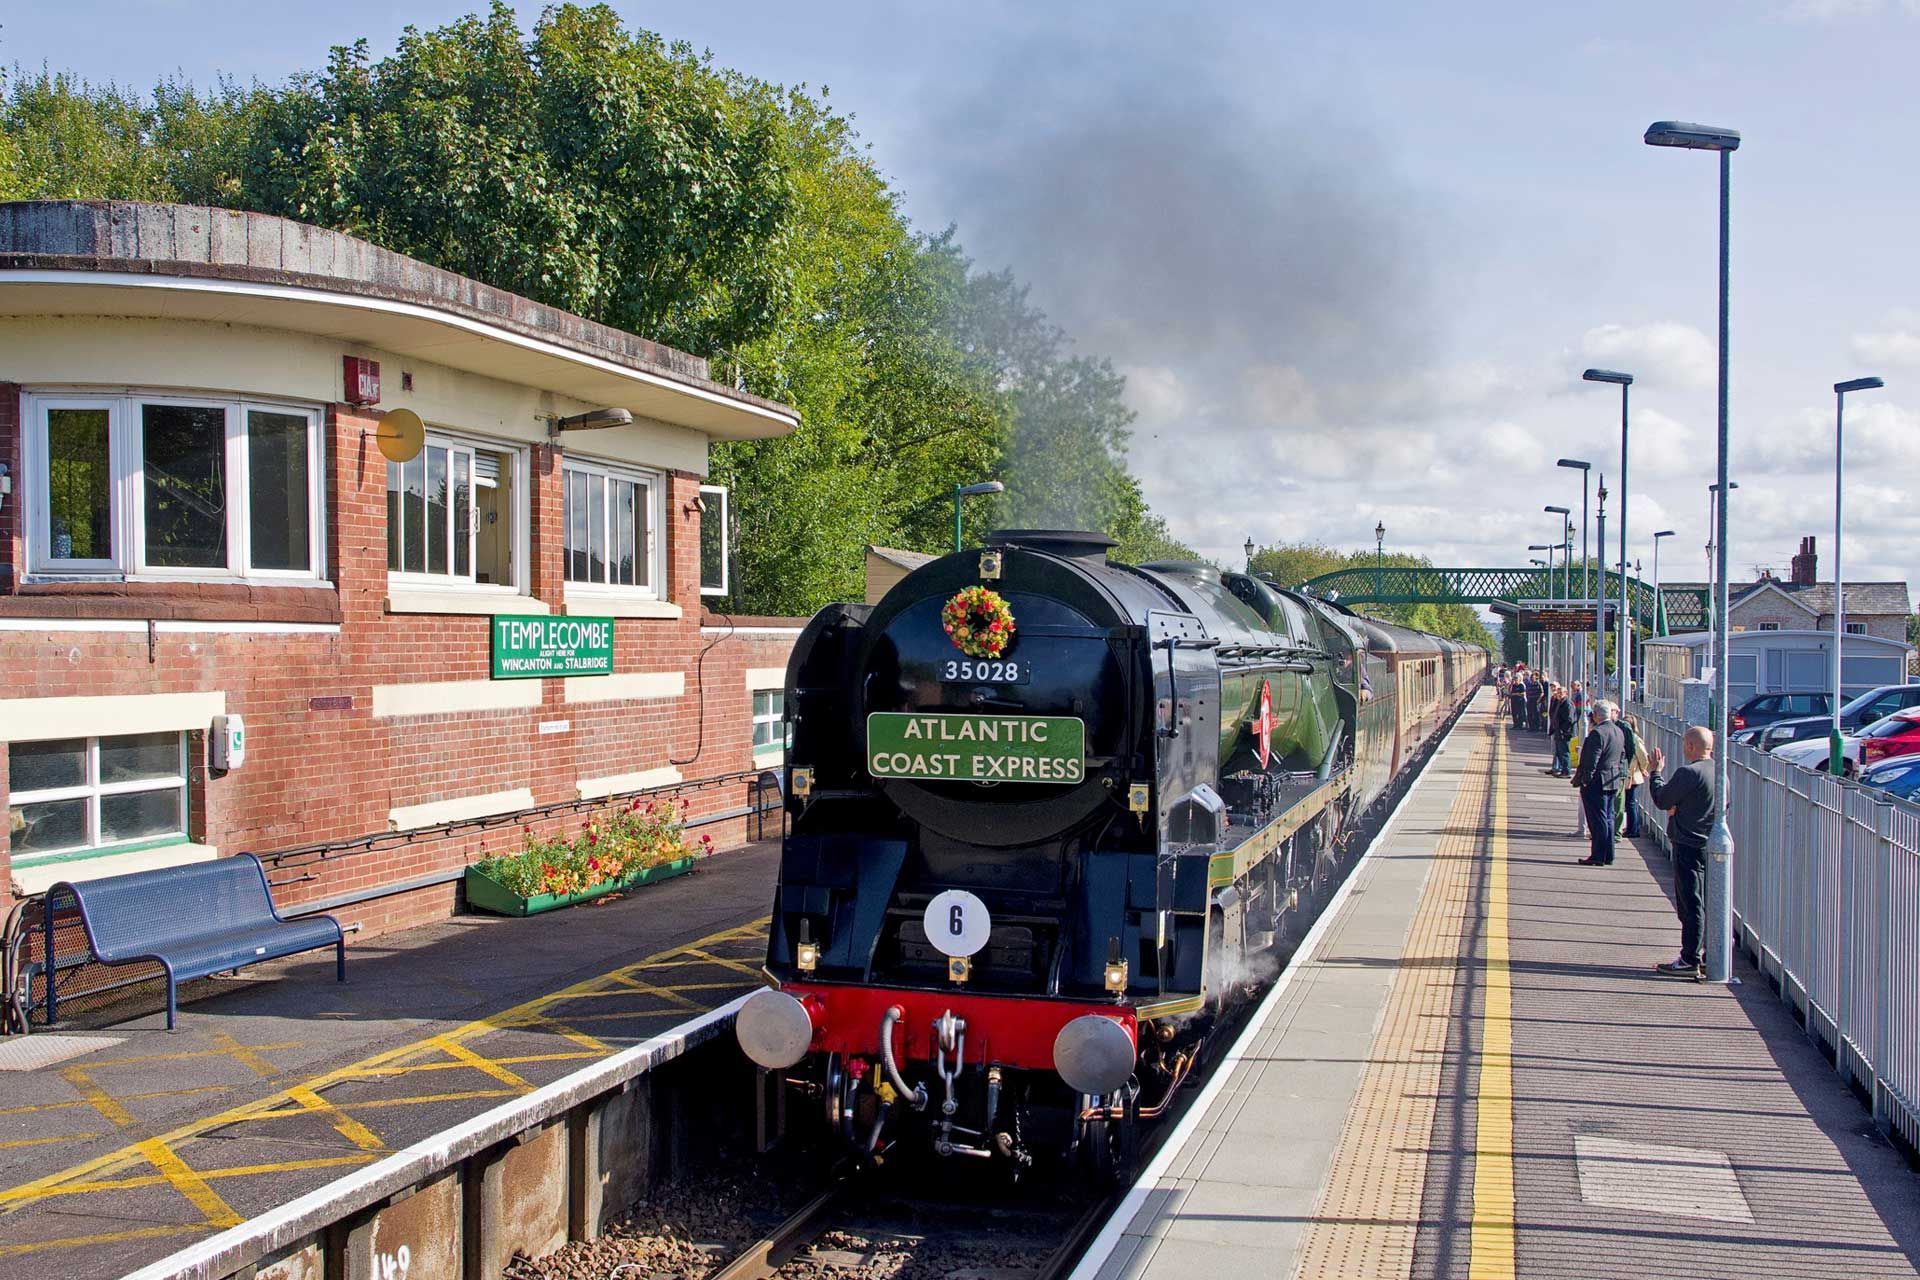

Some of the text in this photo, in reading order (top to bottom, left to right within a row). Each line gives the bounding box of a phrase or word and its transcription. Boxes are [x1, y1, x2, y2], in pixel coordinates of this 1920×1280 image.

[499, 621, 609, 649] TEMPLECOMBE
[502, 658, 552, 670] WINCANTON
[565, 657, 608, 669] STALBRIDGE
[945, 661, 1018, 681] 35028
[903, 718, 1048, 742] ATLANTIC
[872, 752, 1080, 779] COAST EXPRESS
[950, 905, 963, 935] 6
